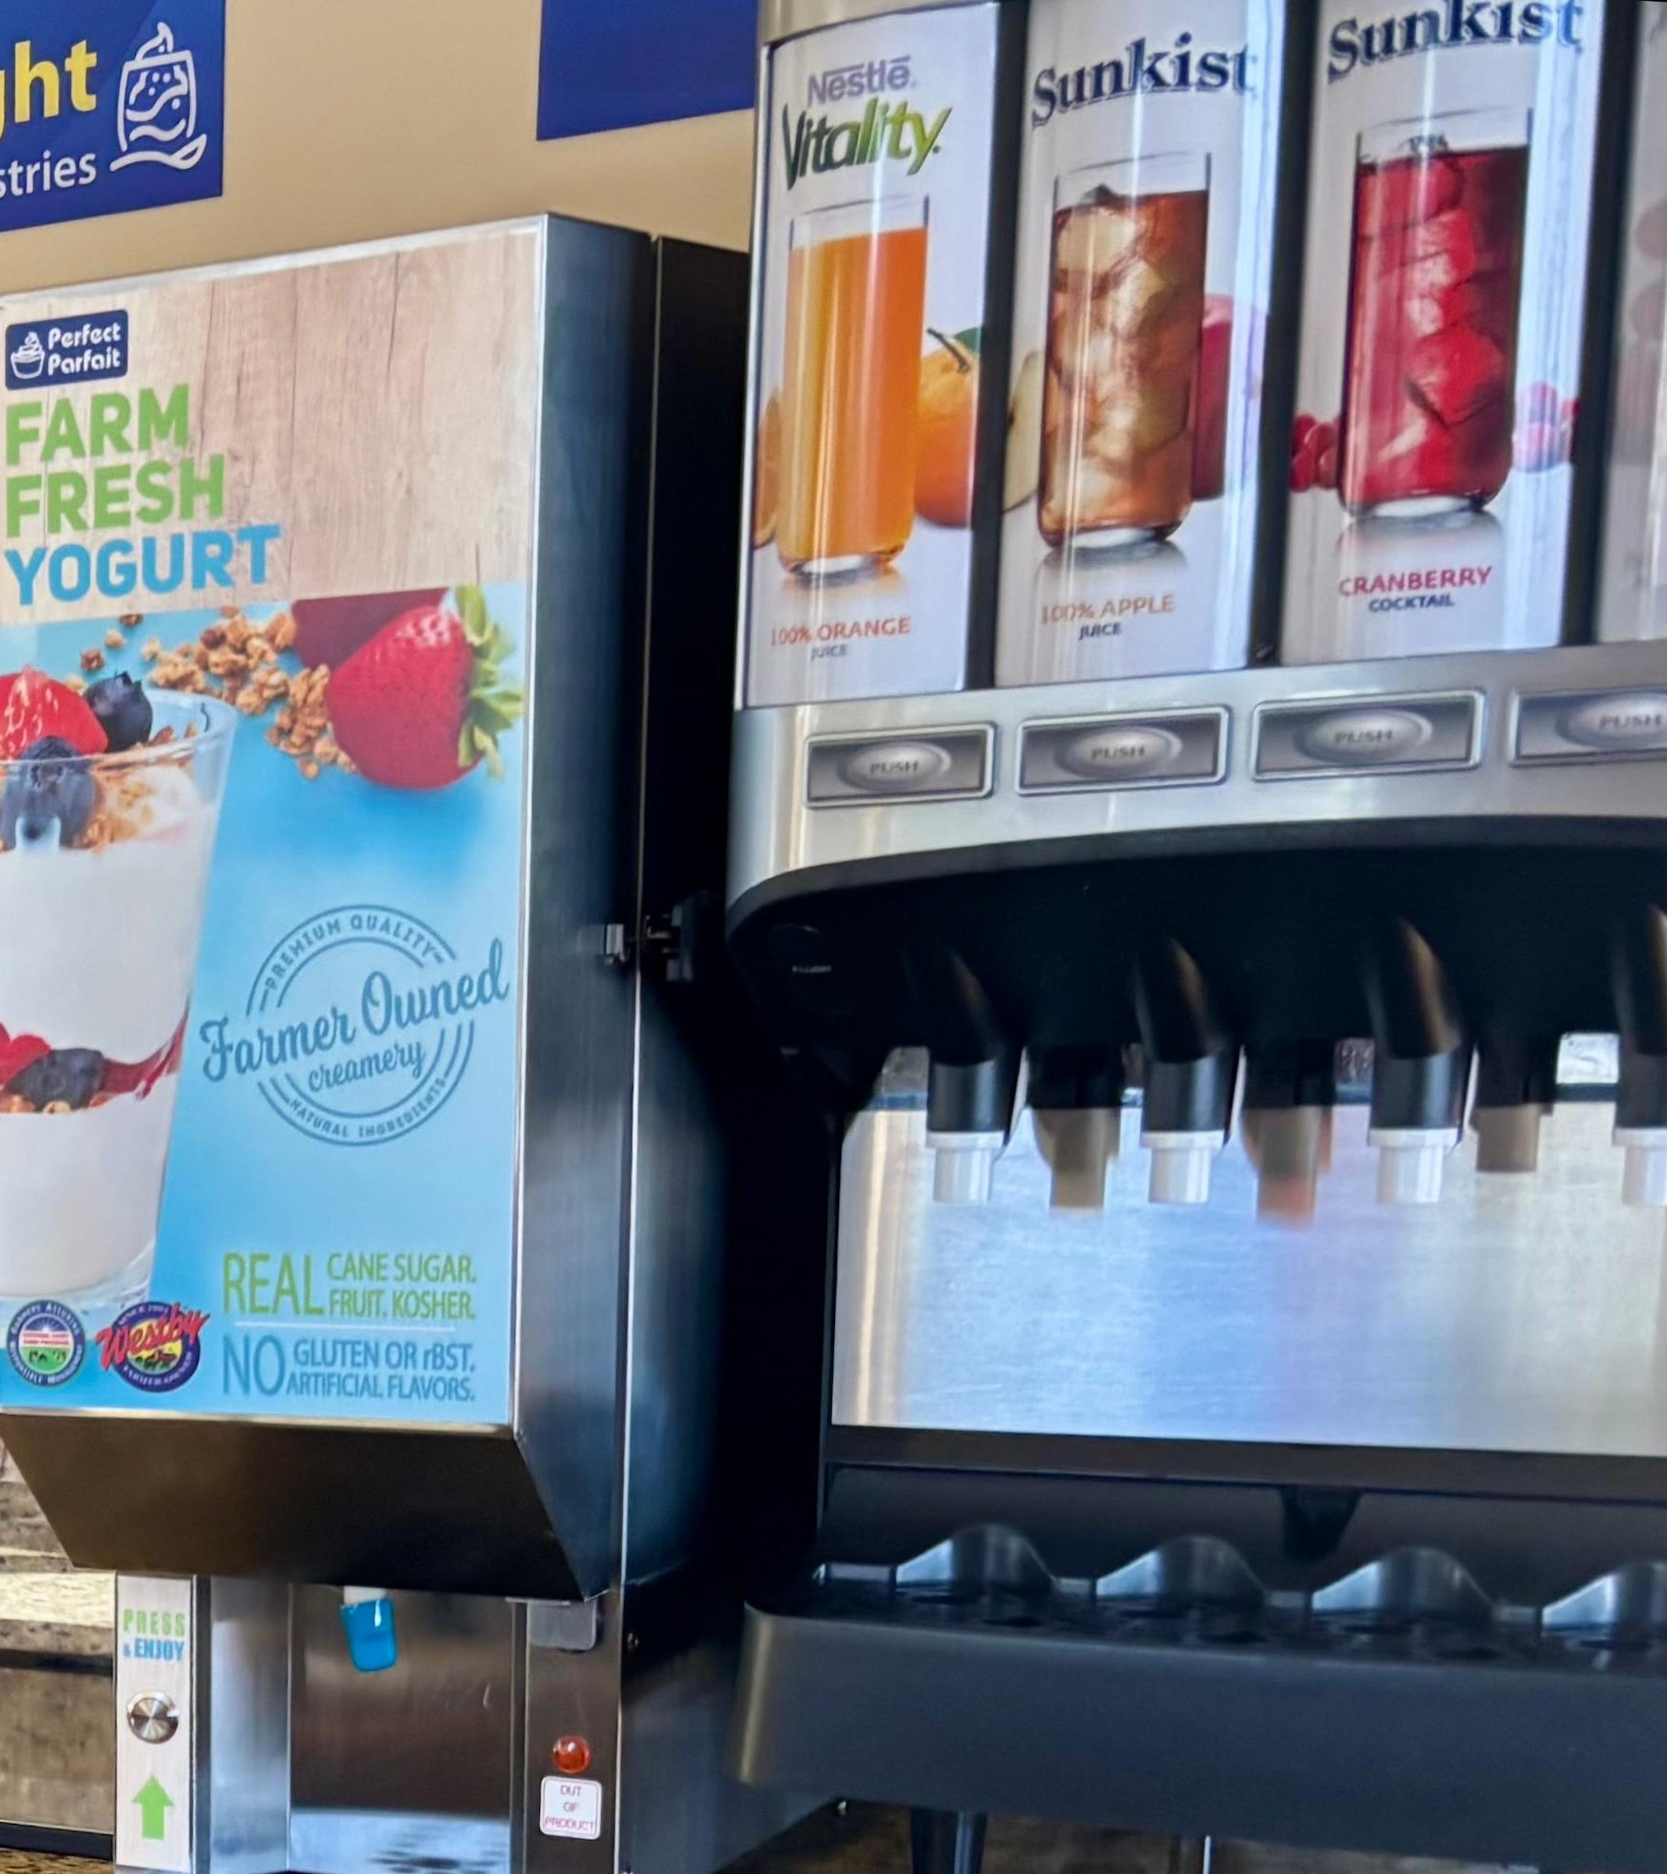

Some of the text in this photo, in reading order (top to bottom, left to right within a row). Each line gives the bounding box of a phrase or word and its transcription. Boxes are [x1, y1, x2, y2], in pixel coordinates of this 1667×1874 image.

[1327, 0, 1584, 84] Sunkist
[1031, 30, 1259, 127] Sunkist
[48, 322, 121, 350] Perfect
[48, 346, 121, 376] Parfait
[5, 384, 190, 466] FARM
[5, 454, 226, 539] FRESH
[4, 524, 281, 607] YOGURT
[1338, 566, 1492, 597] CRANBERRY
[1041, 594, 1175, 624] 100% APPLE
[1369, 593, 1455, 613] COCKTAIL
[771, 616, 912, 646] 100% ORANGE
[1078, 621, 1122, 640] JUICE
[810, 643, 848, 660] JUICE
[266, 918, 341, 992] PREMIUM
[199, 937, 510, 1082] Farmer Owned
[308, 1041, 425, 1093] creamery
[288, 1076, 447, 1138] NATURAL INGREDIENTS
[327, 1252, 476, 1284] CANE SUGAR.
[222, 1253, 325, 1317] REAL
[328, 1288, 476, 1320] FRUIT. KOSHER.
[95, 1301, 211, 1372] Westby
[222, 1333, 286, 1397] NO
[293, 1338, 476, 1372] GLUTEN OR rBST.
[285, 1371, 476, 1402] ARTIFICIAL FLAVORS.
[123, 1608, 186, 1637] PRESS
[123, 1637, 184, 1662] & ENJOY
[560, 1784, 582, 1797] OUT
[544, 1816, 595, 1831] PRODUCT
